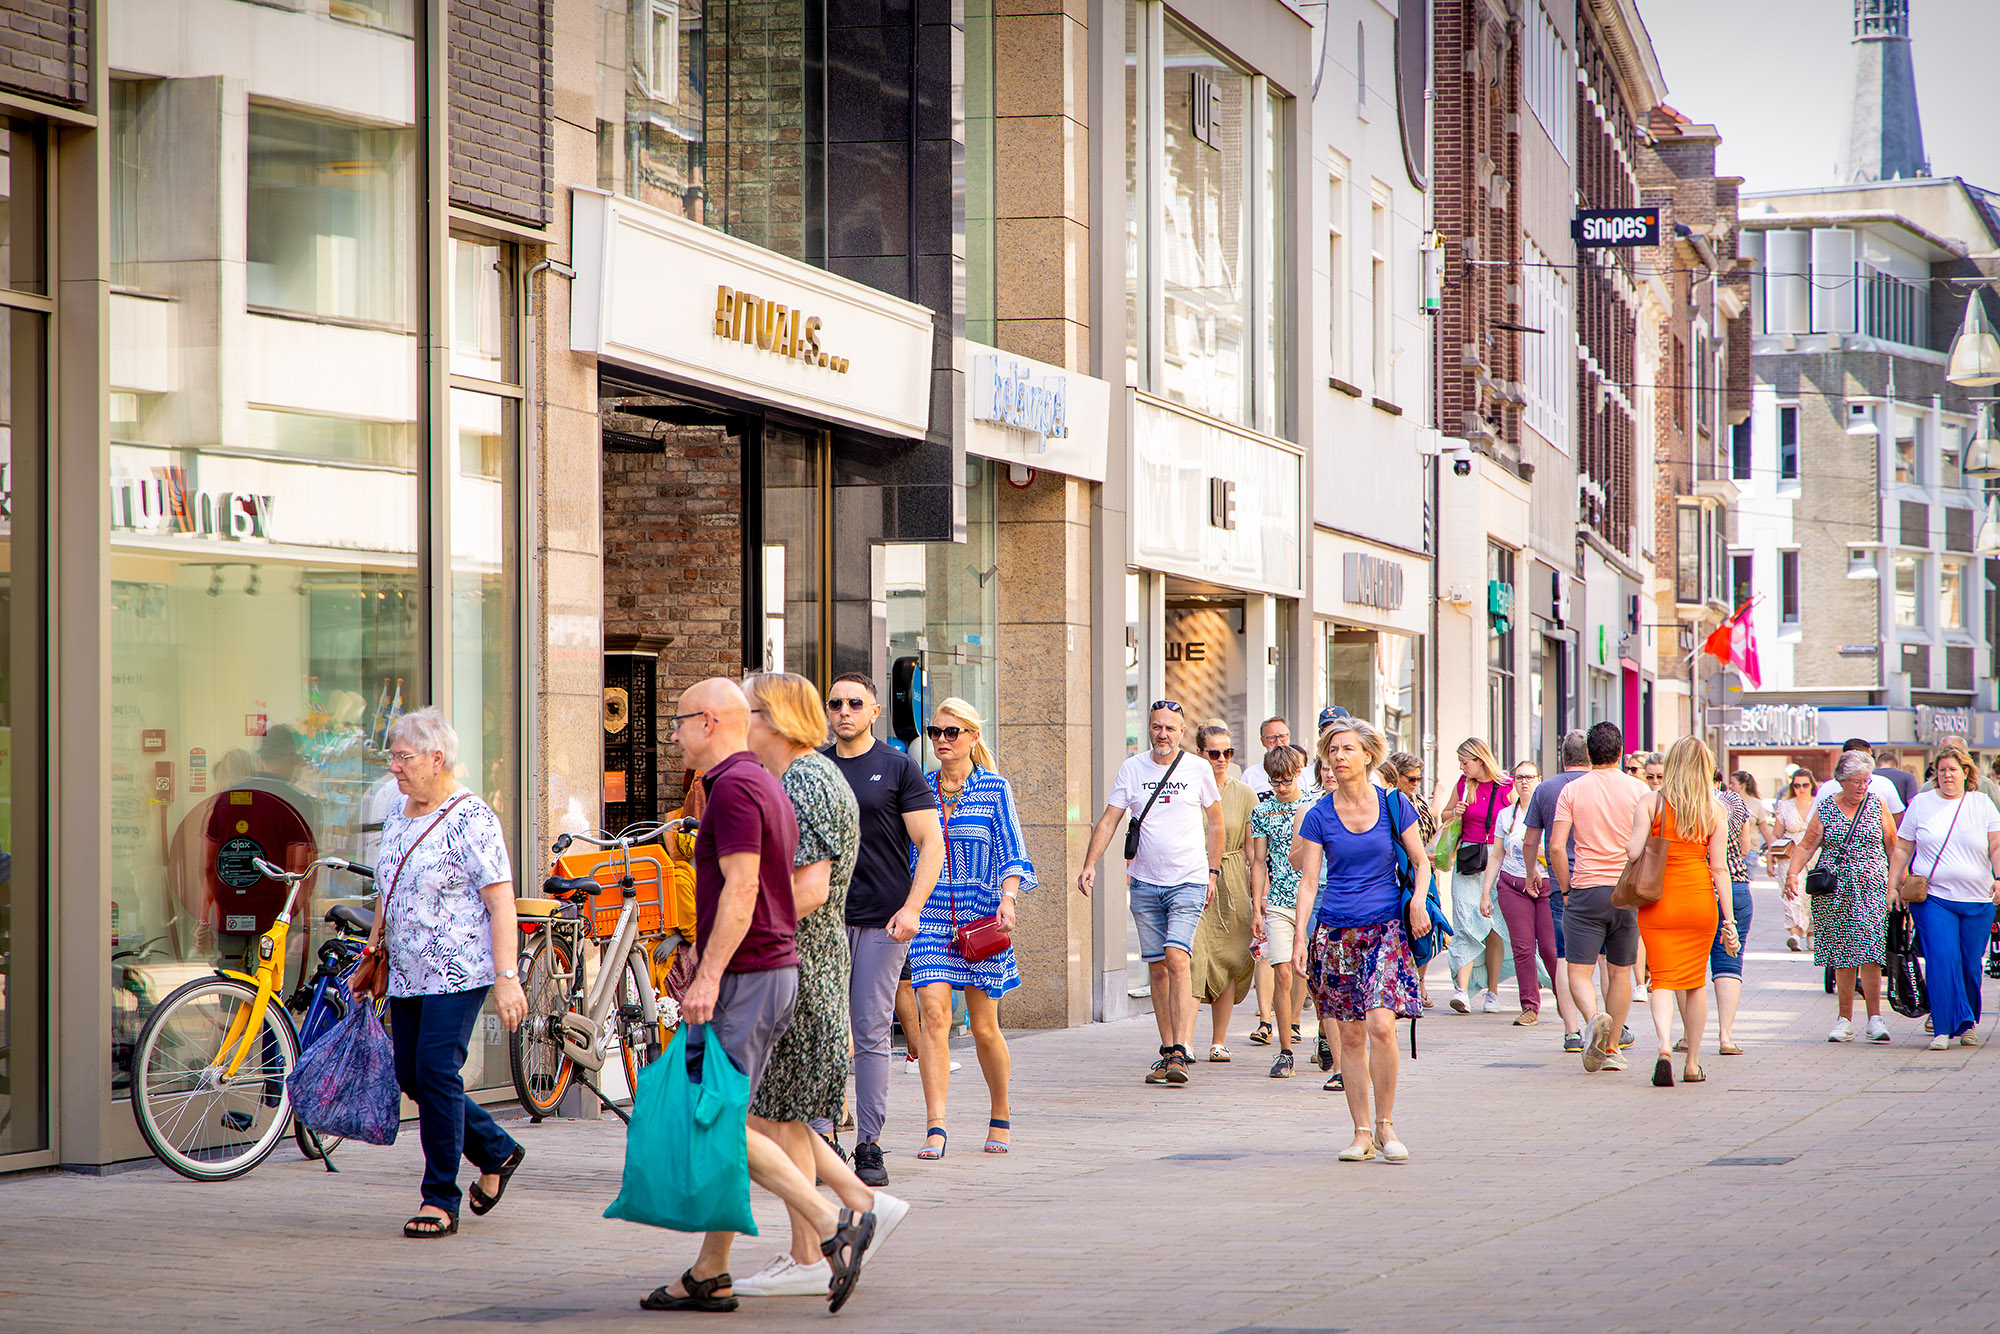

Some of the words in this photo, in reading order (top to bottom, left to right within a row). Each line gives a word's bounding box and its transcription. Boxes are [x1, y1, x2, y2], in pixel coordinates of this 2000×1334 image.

[1583, 216, 1647, 243] snipes
[1210, 476, 1236, 530] WE
[231, 840, 250, 852] ajax
